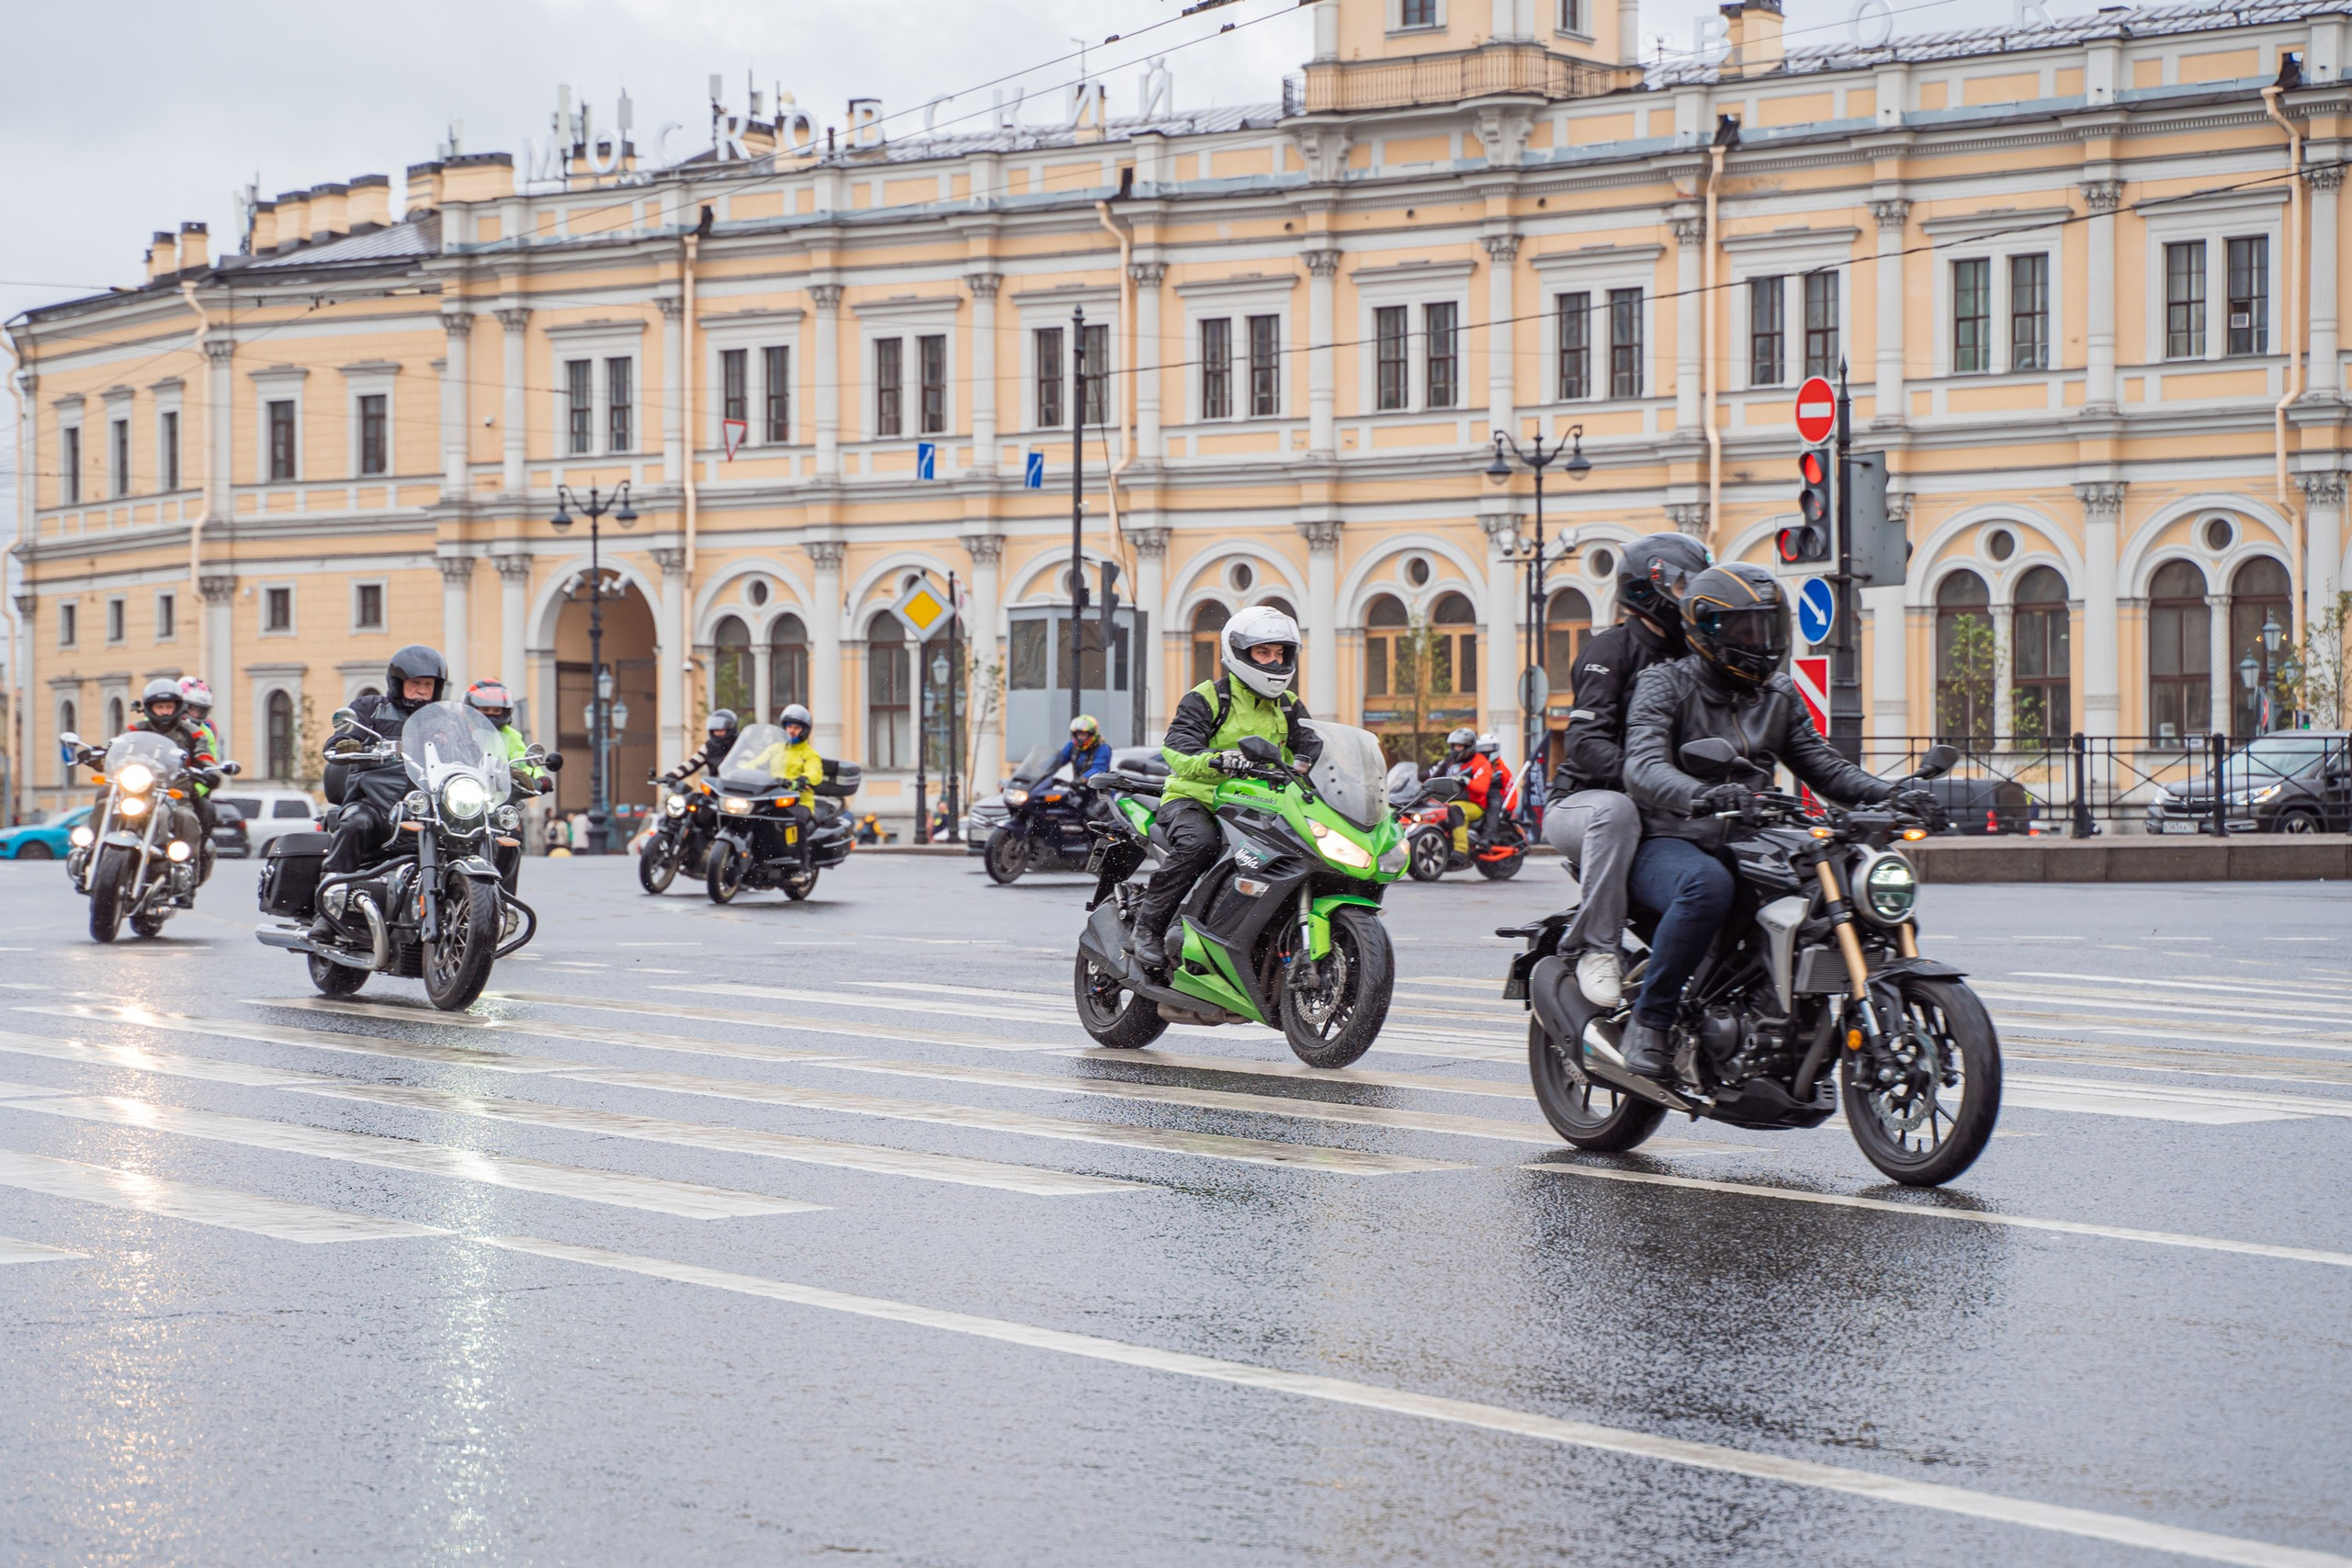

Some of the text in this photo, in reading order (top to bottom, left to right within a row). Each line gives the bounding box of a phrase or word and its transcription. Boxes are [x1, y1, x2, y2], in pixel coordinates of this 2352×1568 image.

[522, 0, 2216, 181] МОСКОВСКИЙ ВОК
[1583, 663, 1611, 675] LS2
[1234, 789, 1278, 806] Kawasaki
[1234, 848, 1259, 869] Ninja
